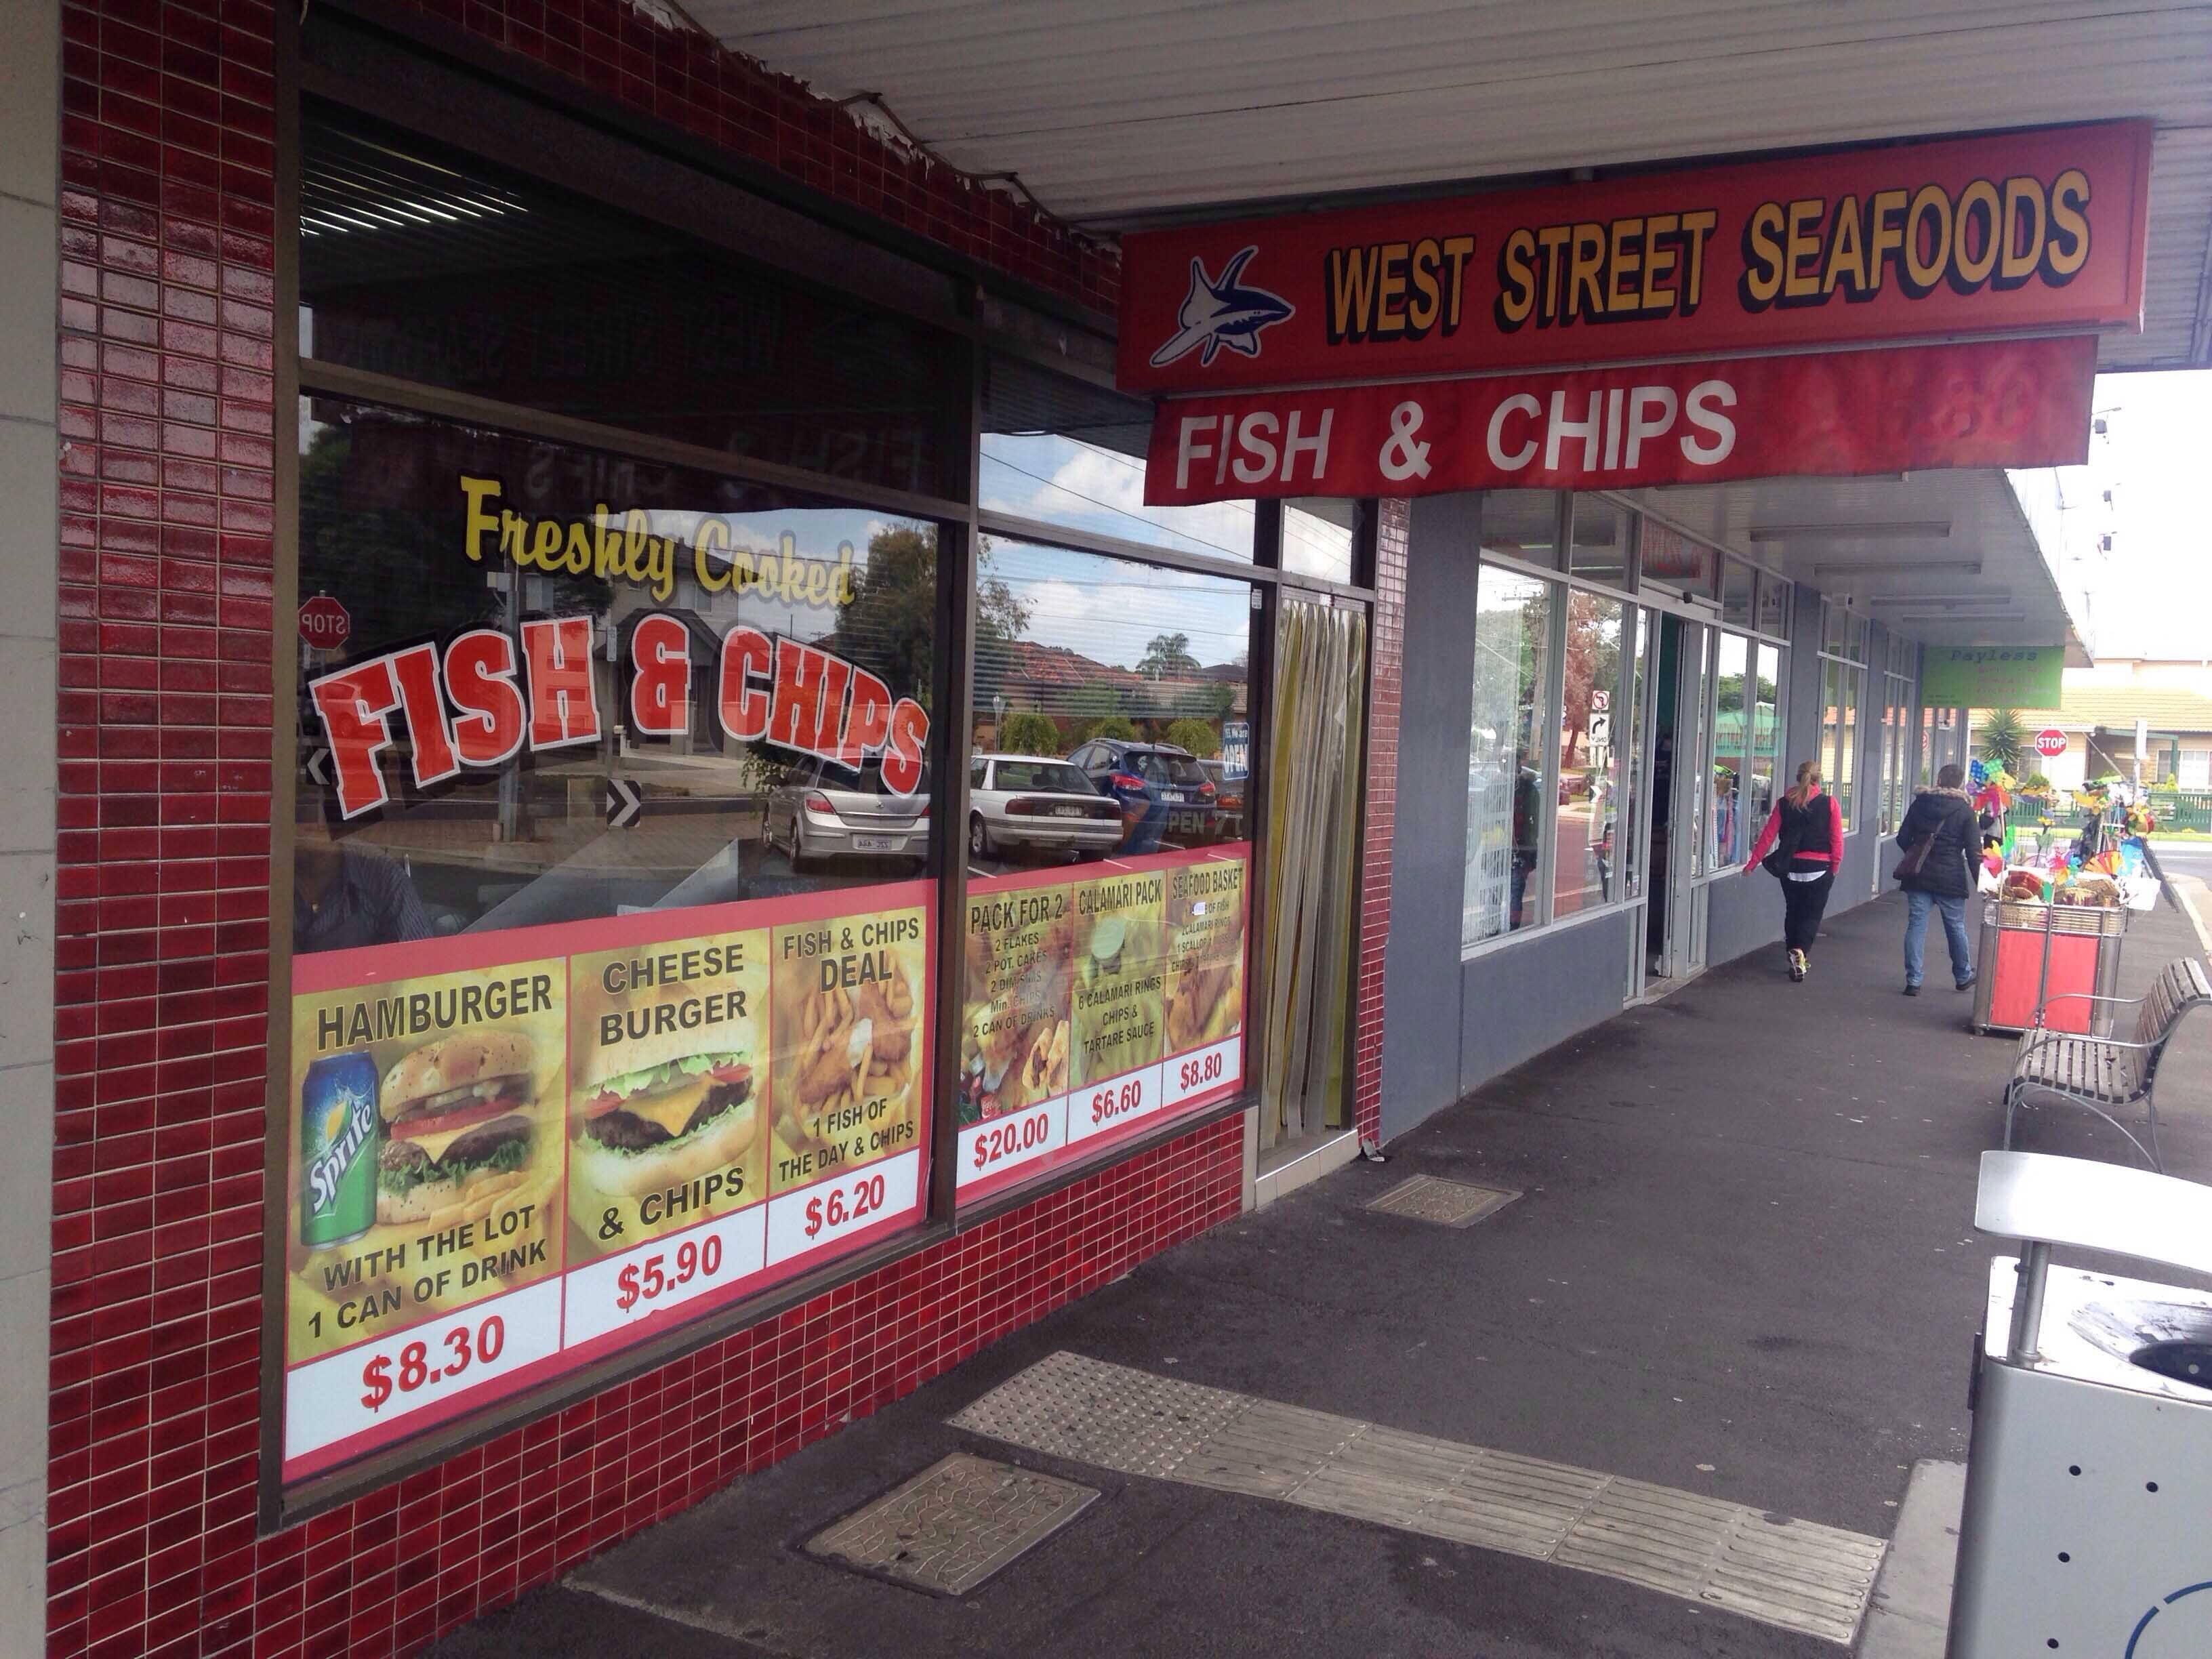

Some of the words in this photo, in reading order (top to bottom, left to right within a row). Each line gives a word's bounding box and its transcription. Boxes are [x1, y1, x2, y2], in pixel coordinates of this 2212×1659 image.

[1324, 234, 1475, 342] WEST
[1494, 209, 1718, 329] STREET
[1738, 167, 2091, 304] SEAFOODS
[1175, 408, 1334, 490] FISH
[1378, 401, 1432, 482] &
[1486, 380, 1737, 472] CHIPS
[459, 474, 676, 601] Freshly
[693, 518, 855, 607] Cooked
[1950, 649, 2039, 663] Payless
[308, 615, 602, 821] FISH
[630, 612, 691, 735] &
[718, 625, 931, 799] CHIPS
[1225, 743, 1248, 773] OPEN
[2038, 737, 2066, 749] STOP
[1167, 811, 1205, 834] PEN
[1078, 882, 1133, 916] CALAMARI
[1136, 879, 1162, 906] PACK
[1172, 872, 1210, 900] SEAFOOD
[1212, 867, 1243, 893] BASKET
[970, 897, 1015, 935] PACK
[1019, 895, 1048, 927] FOR
[1054, 893, 1063, 921] 2
[1209, 903, 1216, 914] OF
[782, 930, 833, 962] FISH
[840, 924, 855, 949] &
[861, 917, 920, 946] CHIPS
[996, 939, 1001, 952] 2
[1004, 933, 1040, 950] FLAKES
[602, 943, 745, 995] CHEESE
[819, 949, 893, 994] DEAL
[985, 962, 991, 975] 2
[994, 957, 1015, 972] POT.
[1017, 950, 1047, 968] CAKES
[991, 981, 997, 994] 2
[991, 999, 1010, 1015] Min.
[1078, 996, 1084, 1010] 6
[1087, 986, 1132, 1008] CALAMARI
[1135, 976, 1162, 996] RINGS
[316, 973, 553, 1052] HAMBURGER
[599, 990, 747, 1047] BURGER
[973, 1025, 979, 1039] 2
[982, 1020, 1002, 1036] CAN
[1006, 1016, 1017, 1029] OF
[1021, 1006, 1055, 1026] DRINKS
[1102, 1006, 1129, 1027] CHIPS
[1131, 1004, 1139, 1019] &
[1084, 1029, 1124, 1055] TARTARE
[1126, 1021, 1155, 1043] SAUCE
[1181, 1051, 1223, 1094] $8.80
[813, 1118, 821, 1135] 1
[827, 1103, 863, 1134] FISH
[867, 1097, 888, 1121] OF
[1091, 1079, 1142, 1126] $6.60
[310, 1102, 373, 1214] Sprite
[779, 1156, 813, 1184] THE
[818, 1143, 849, 1171] DAY
[854, 1138, 865, 1158] &
[869, 1120, 914, 1151] CHIPS
[973, 1113, 1049, 1171] $20.00
[597, 1207, 625, 1242] &
[639, 1166, 745, 1227] CHIPS
[804, 1173, 886, 1240] $6.20
[323, 1242, 407, 1292] WITH
[417, 1220, 474, 1262] THE
[483, 1204, 536, 1243] LOT
[307, 1311, 323, 1339] 1
[336, 1284, 403, 1328] CAN
[413, 1270, 451, 1305] OF
[461, 1238, 548, 1290] DRINK
[617, 1234, 722, 1314] $5.90
[360, 1315, 505, 1414] $8.30
